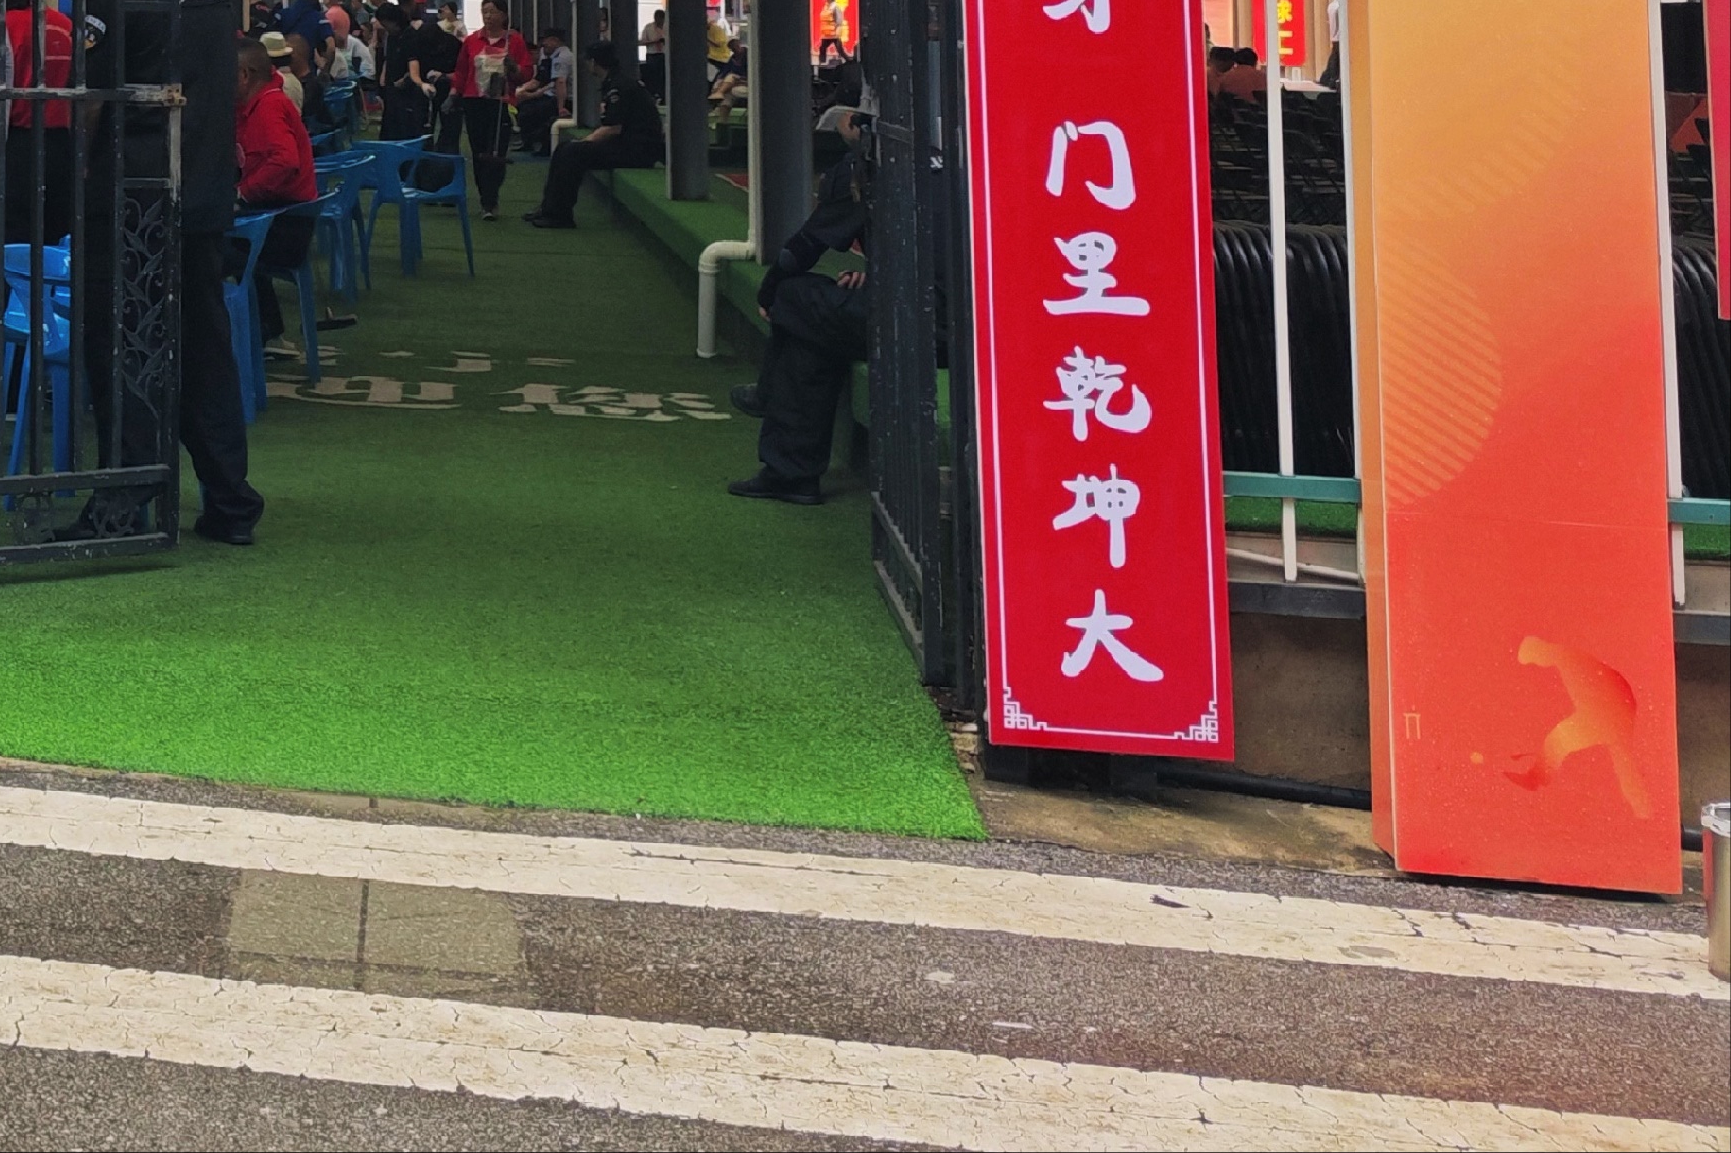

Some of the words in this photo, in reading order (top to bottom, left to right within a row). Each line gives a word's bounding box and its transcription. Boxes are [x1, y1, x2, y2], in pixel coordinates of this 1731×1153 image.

[1042, 121, 1164, 682] 门里乾坤大
